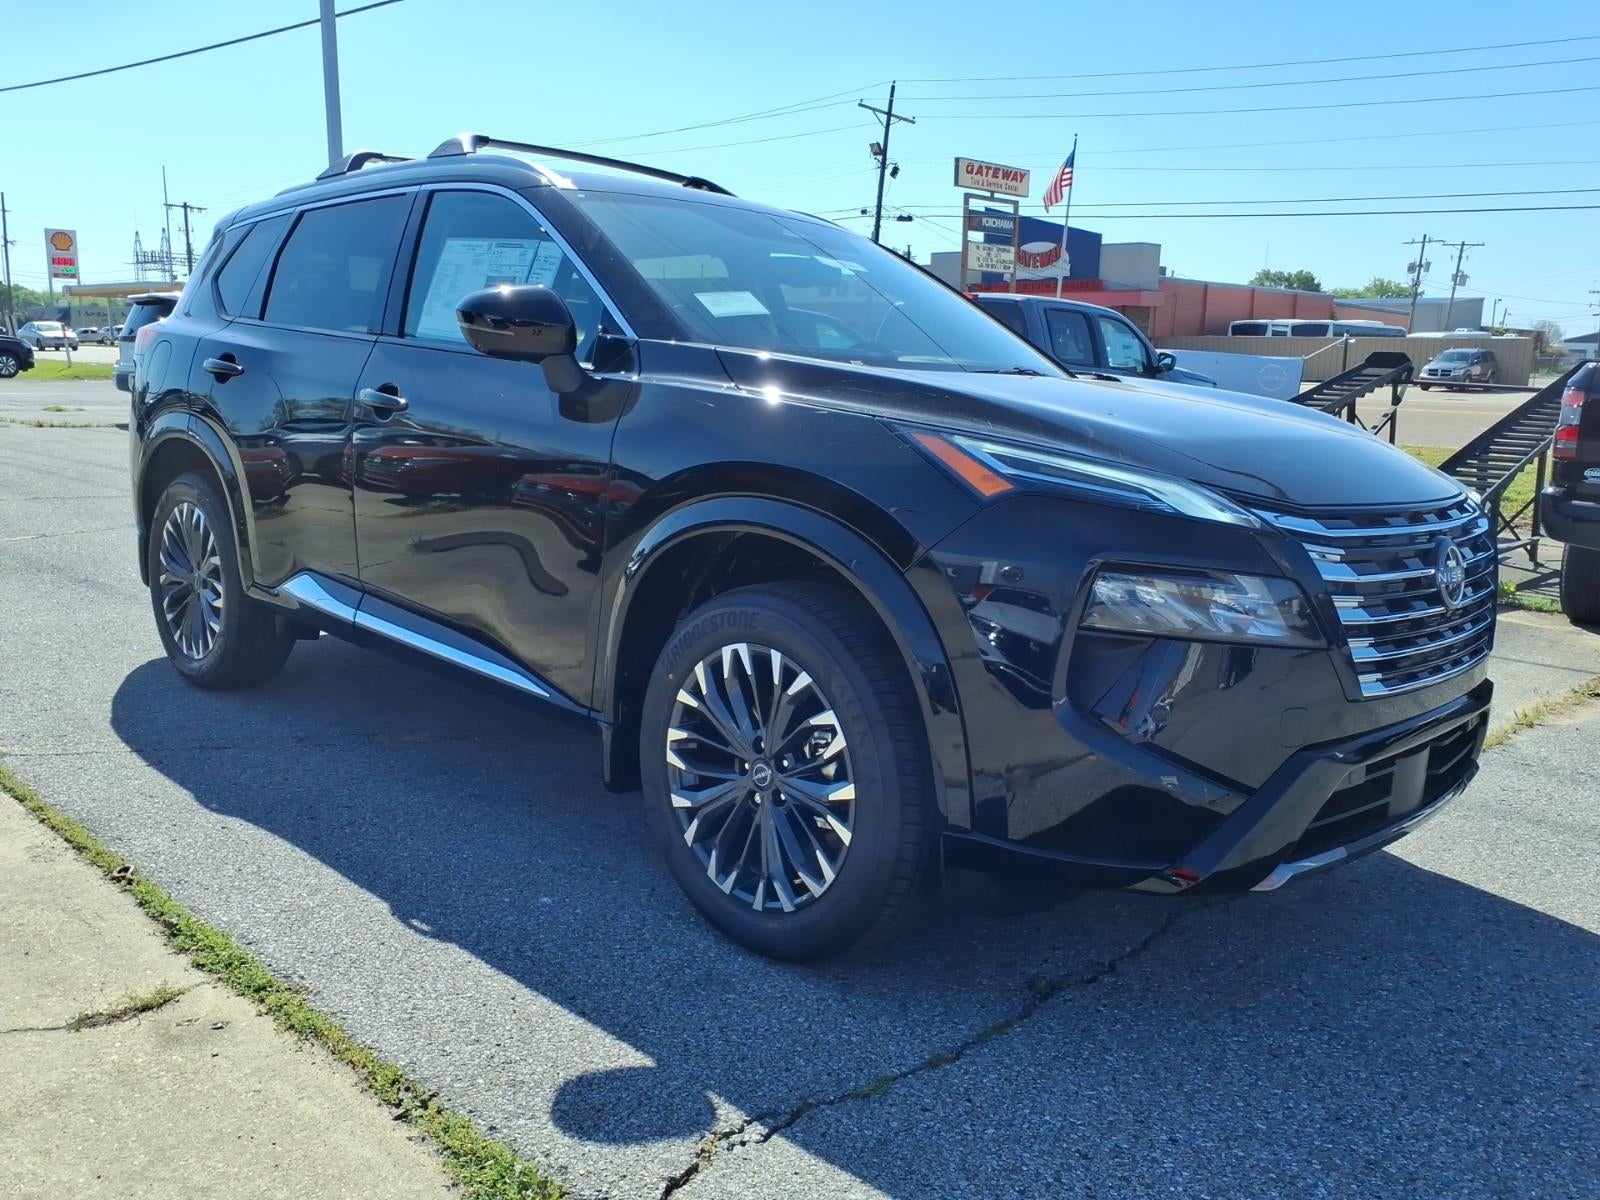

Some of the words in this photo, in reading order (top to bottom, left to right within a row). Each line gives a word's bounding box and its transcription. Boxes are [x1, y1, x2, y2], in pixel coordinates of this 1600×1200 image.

[965, 162, 1027, 183] GATEWAY
[981, 216, 1014, 230] YOKOHAMA
[1017, 243, 1062, 269] ATEWAY
